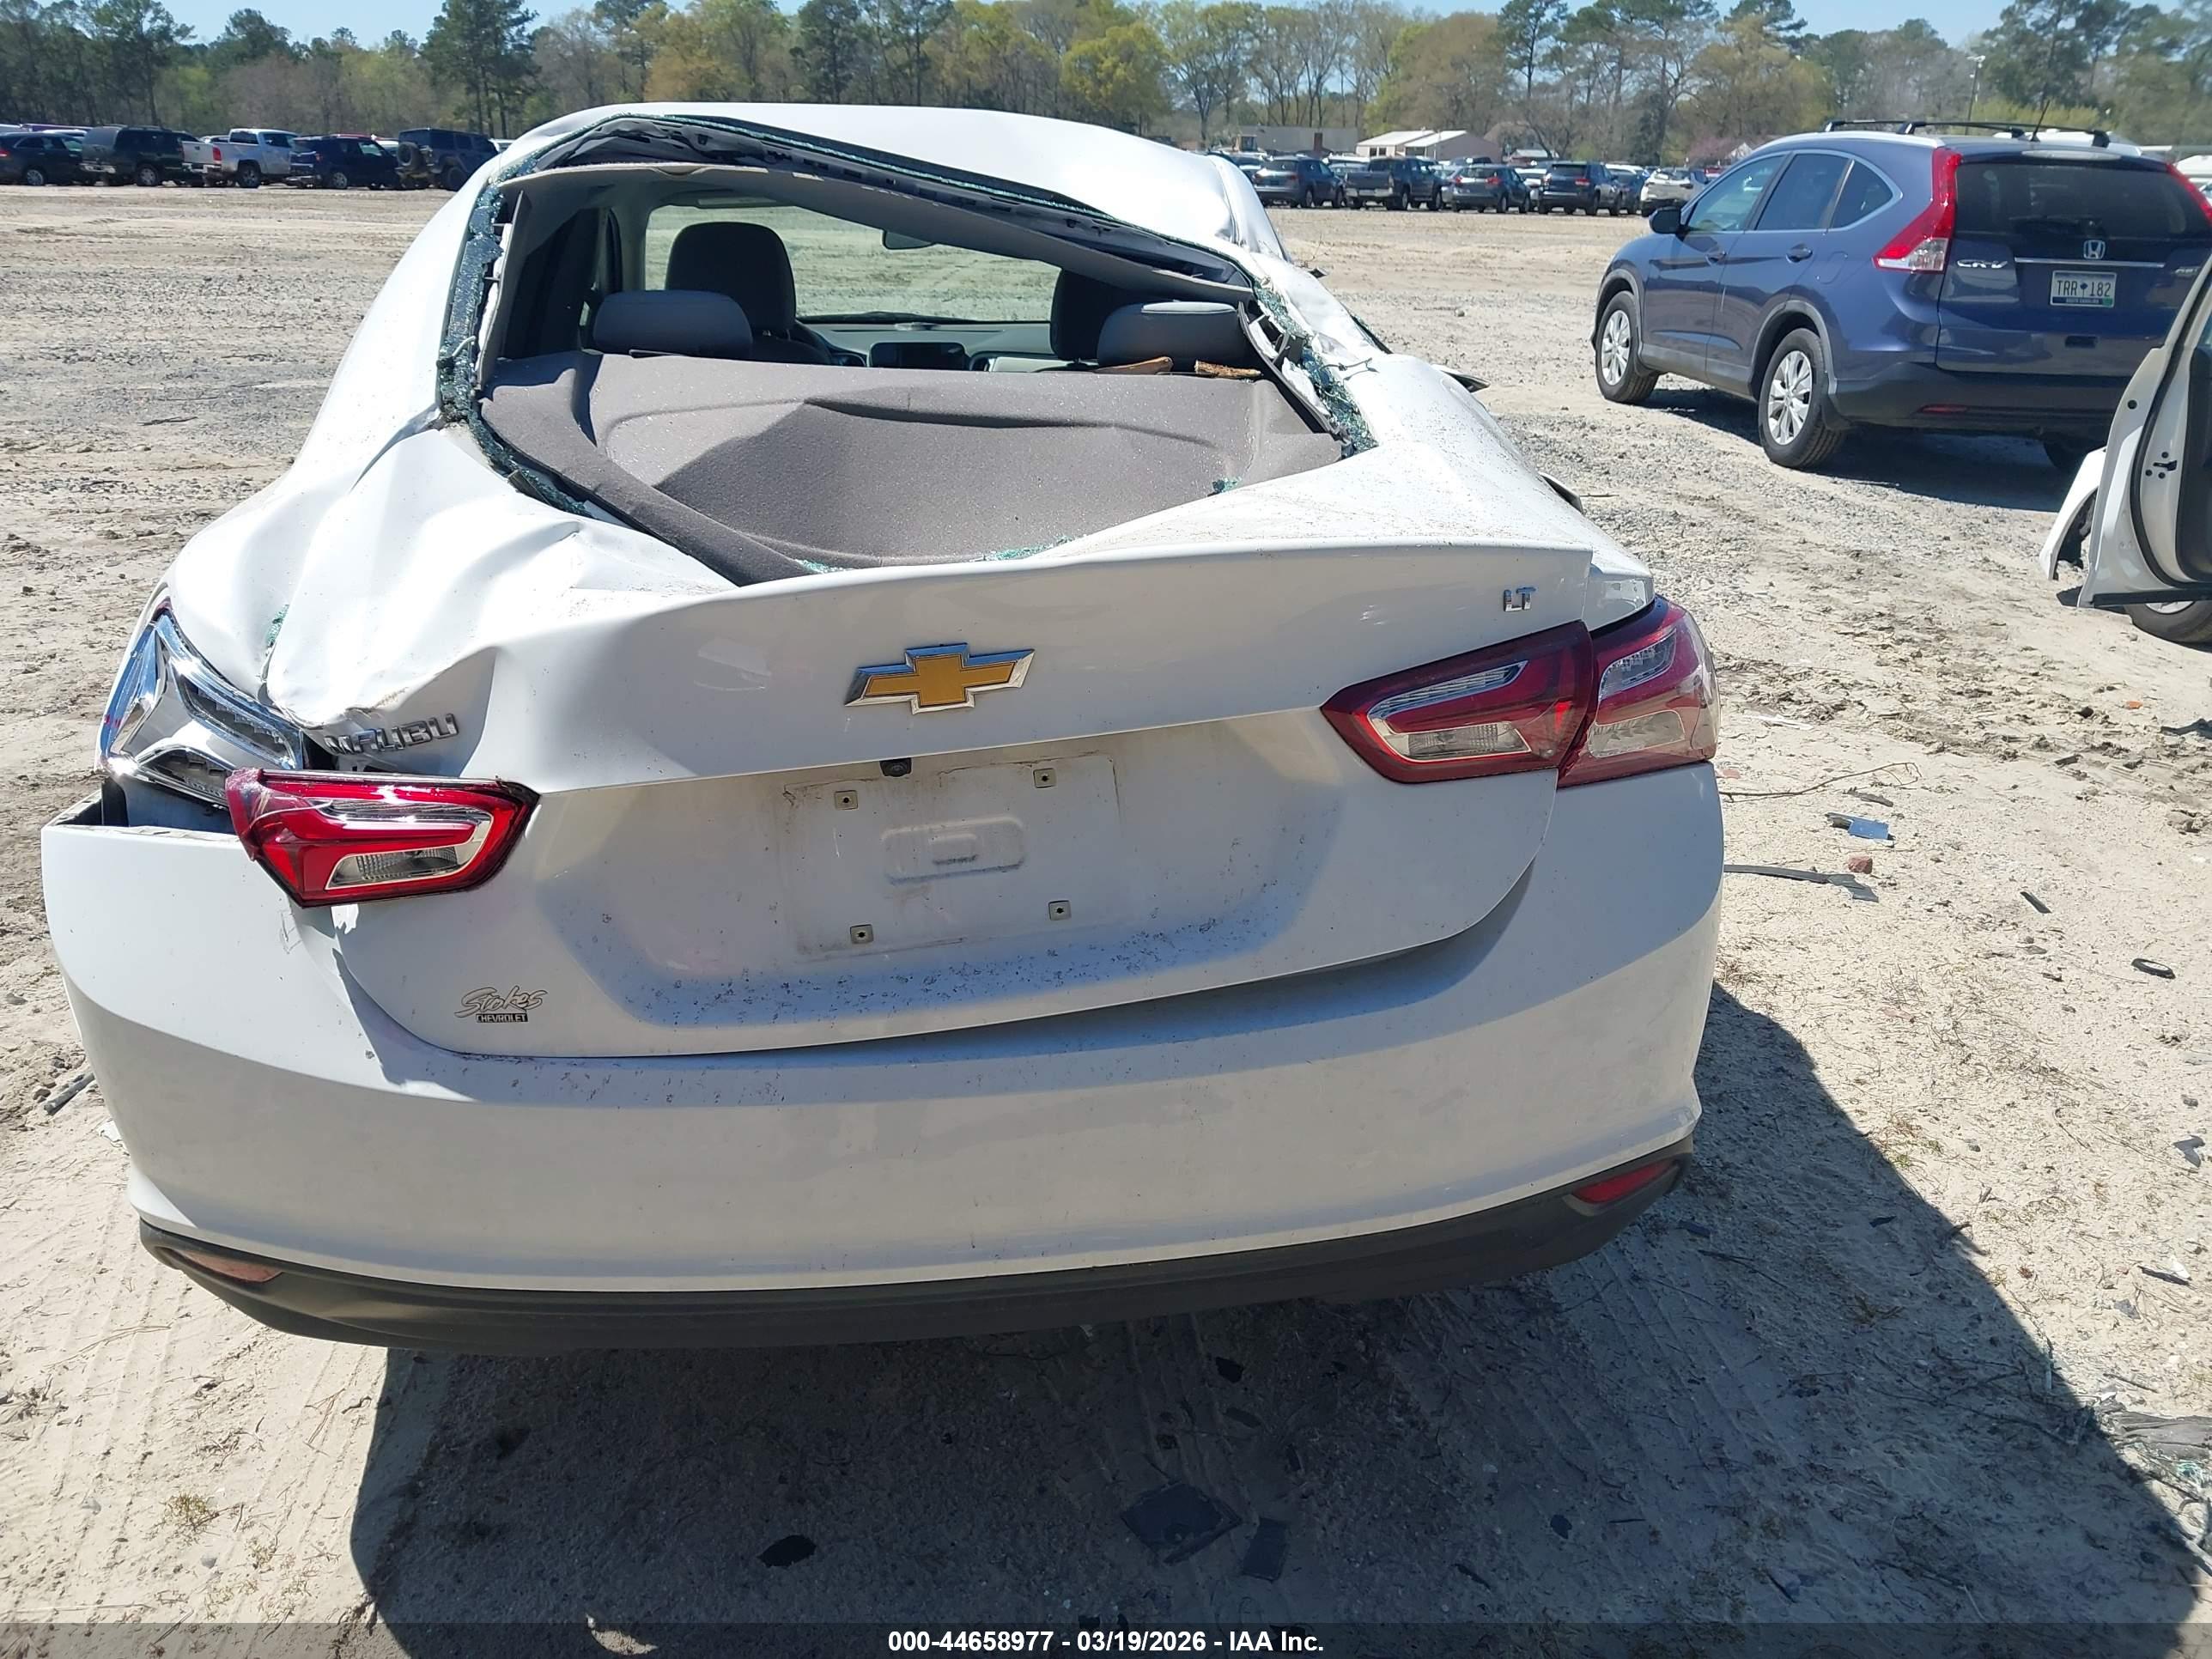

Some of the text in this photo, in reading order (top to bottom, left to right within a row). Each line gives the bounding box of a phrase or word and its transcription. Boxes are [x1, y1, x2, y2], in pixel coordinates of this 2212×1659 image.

[2057, 280, 2112, 297] TRR 182
[1504, 586, 1536, 612] LT
[324, 713, 459, 755] MALIBU
[453, 985, 548, 1018] Stokes
[476, 1013, 528, 1023] CHEVROLET
